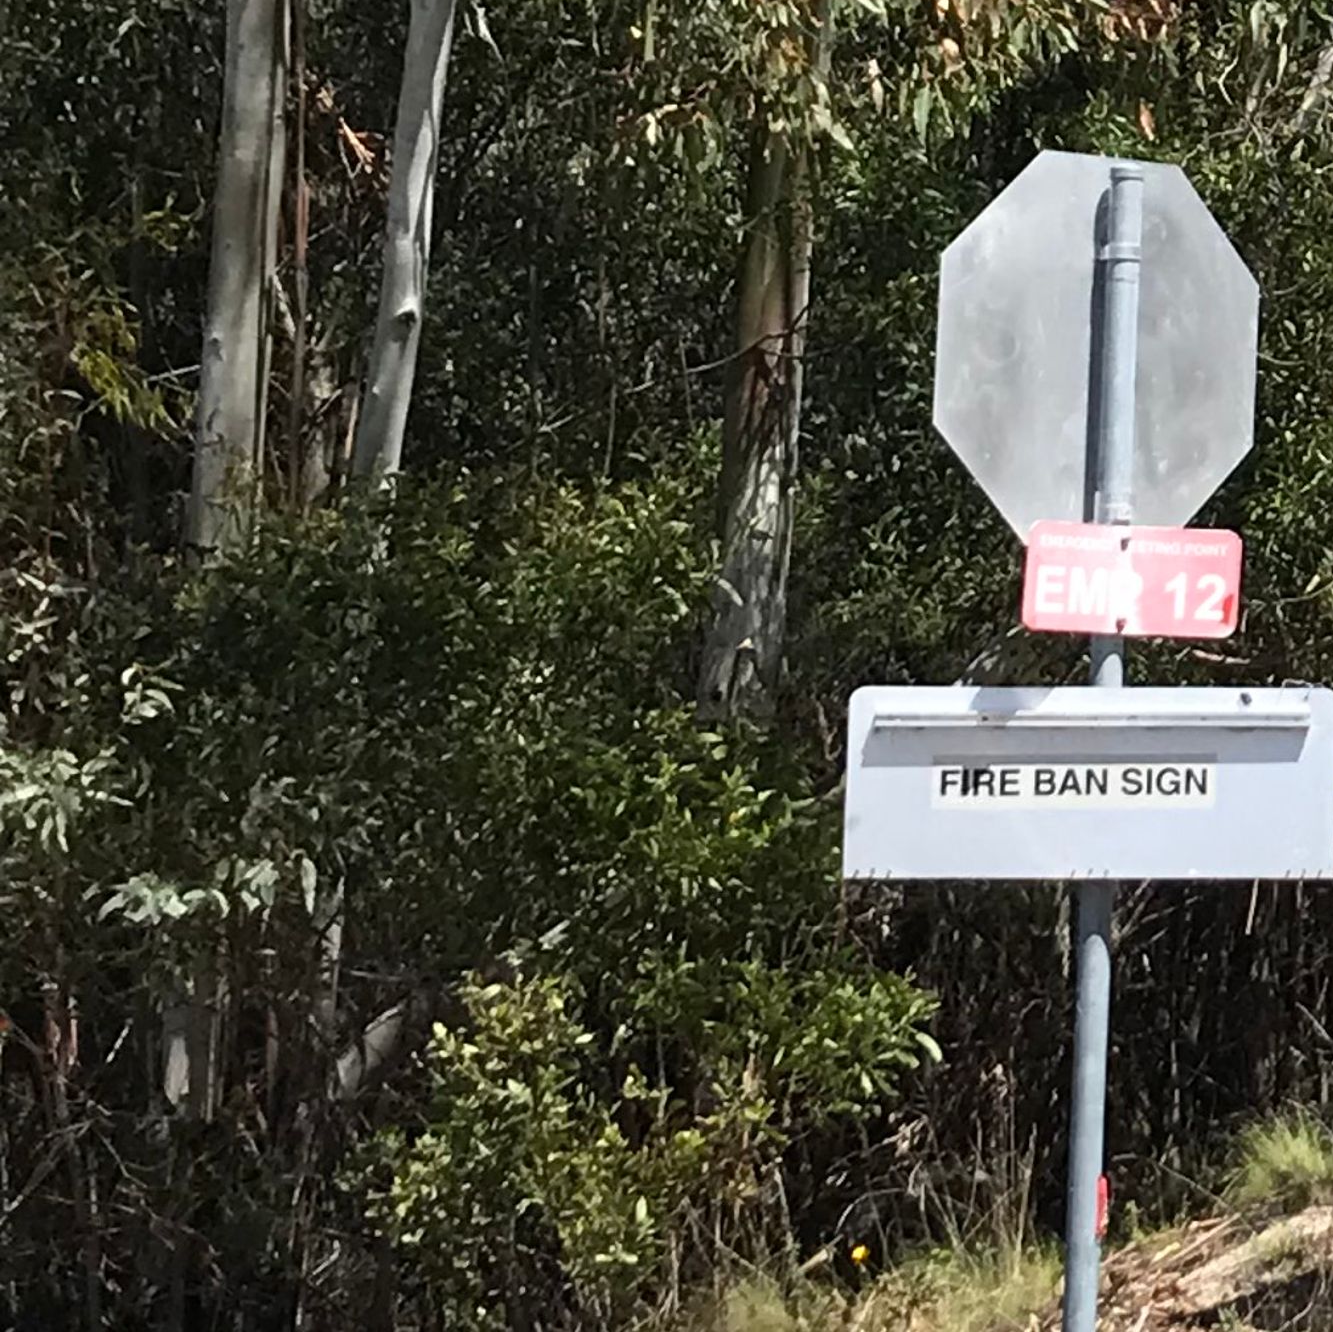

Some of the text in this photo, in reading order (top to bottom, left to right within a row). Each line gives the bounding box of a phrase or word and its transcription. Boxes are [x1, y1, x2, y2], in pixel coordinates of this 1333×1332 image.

[1165, 571, 1227, 621] 12
[940, 766, 1208, 797] FIRE BAN SIGN
